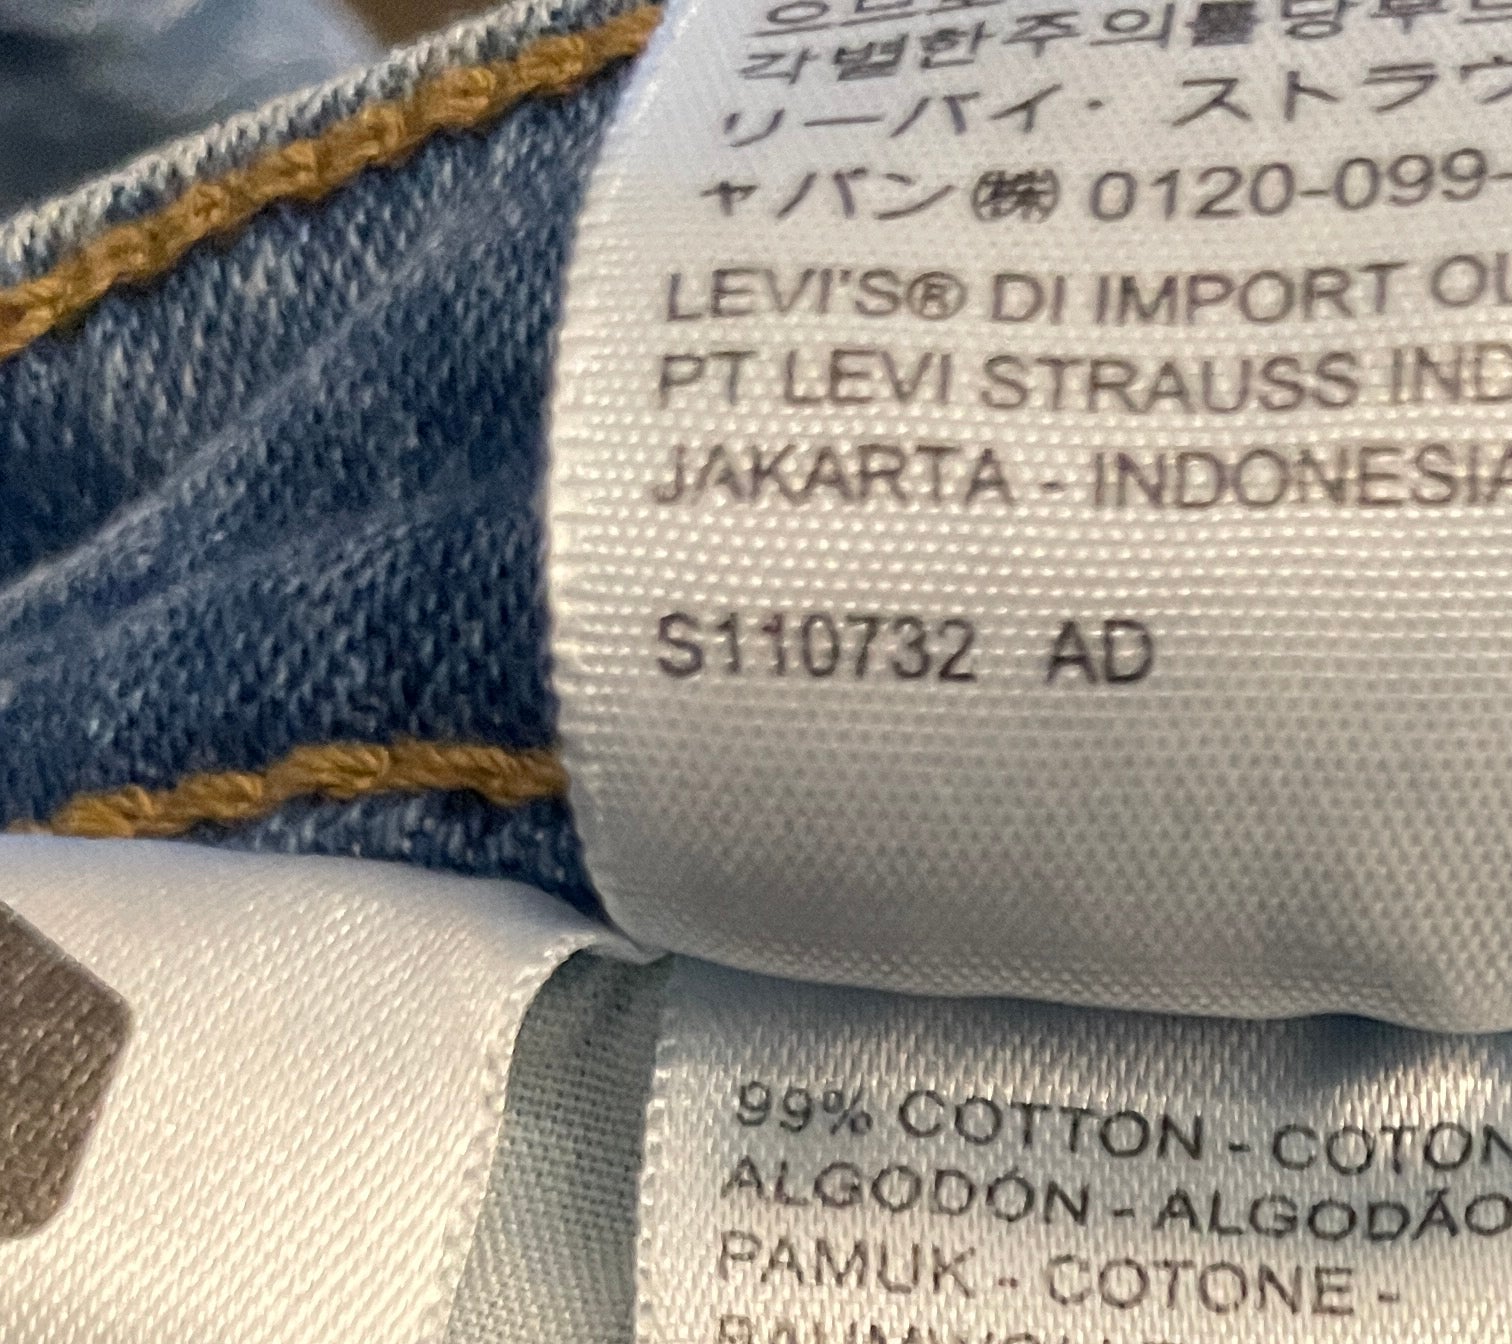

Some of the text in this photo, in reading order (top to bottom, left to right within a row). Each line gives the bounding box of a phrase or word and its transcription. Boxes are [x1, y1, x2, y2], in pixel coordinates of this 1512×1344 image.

[990, 273, 1066, 324] DI
[1096, 261, 1408, 326] IMPORT
[658, 349, 758, 407] PT
[783, 348, 952, 404] LEVI
[980, 350, 1358, 414] STRAUSS
[652, 443, 1016, 502] JAKARTA
[657, 611, 1155, 685] S110732 AD
[735, 1081, 873, 1136] 99%
[898, 1089, 1202, 1161] COTTON
[718, 1229, 977, 1299] PAMUK
[1047, 1252, 1355, 1317] COTONE
